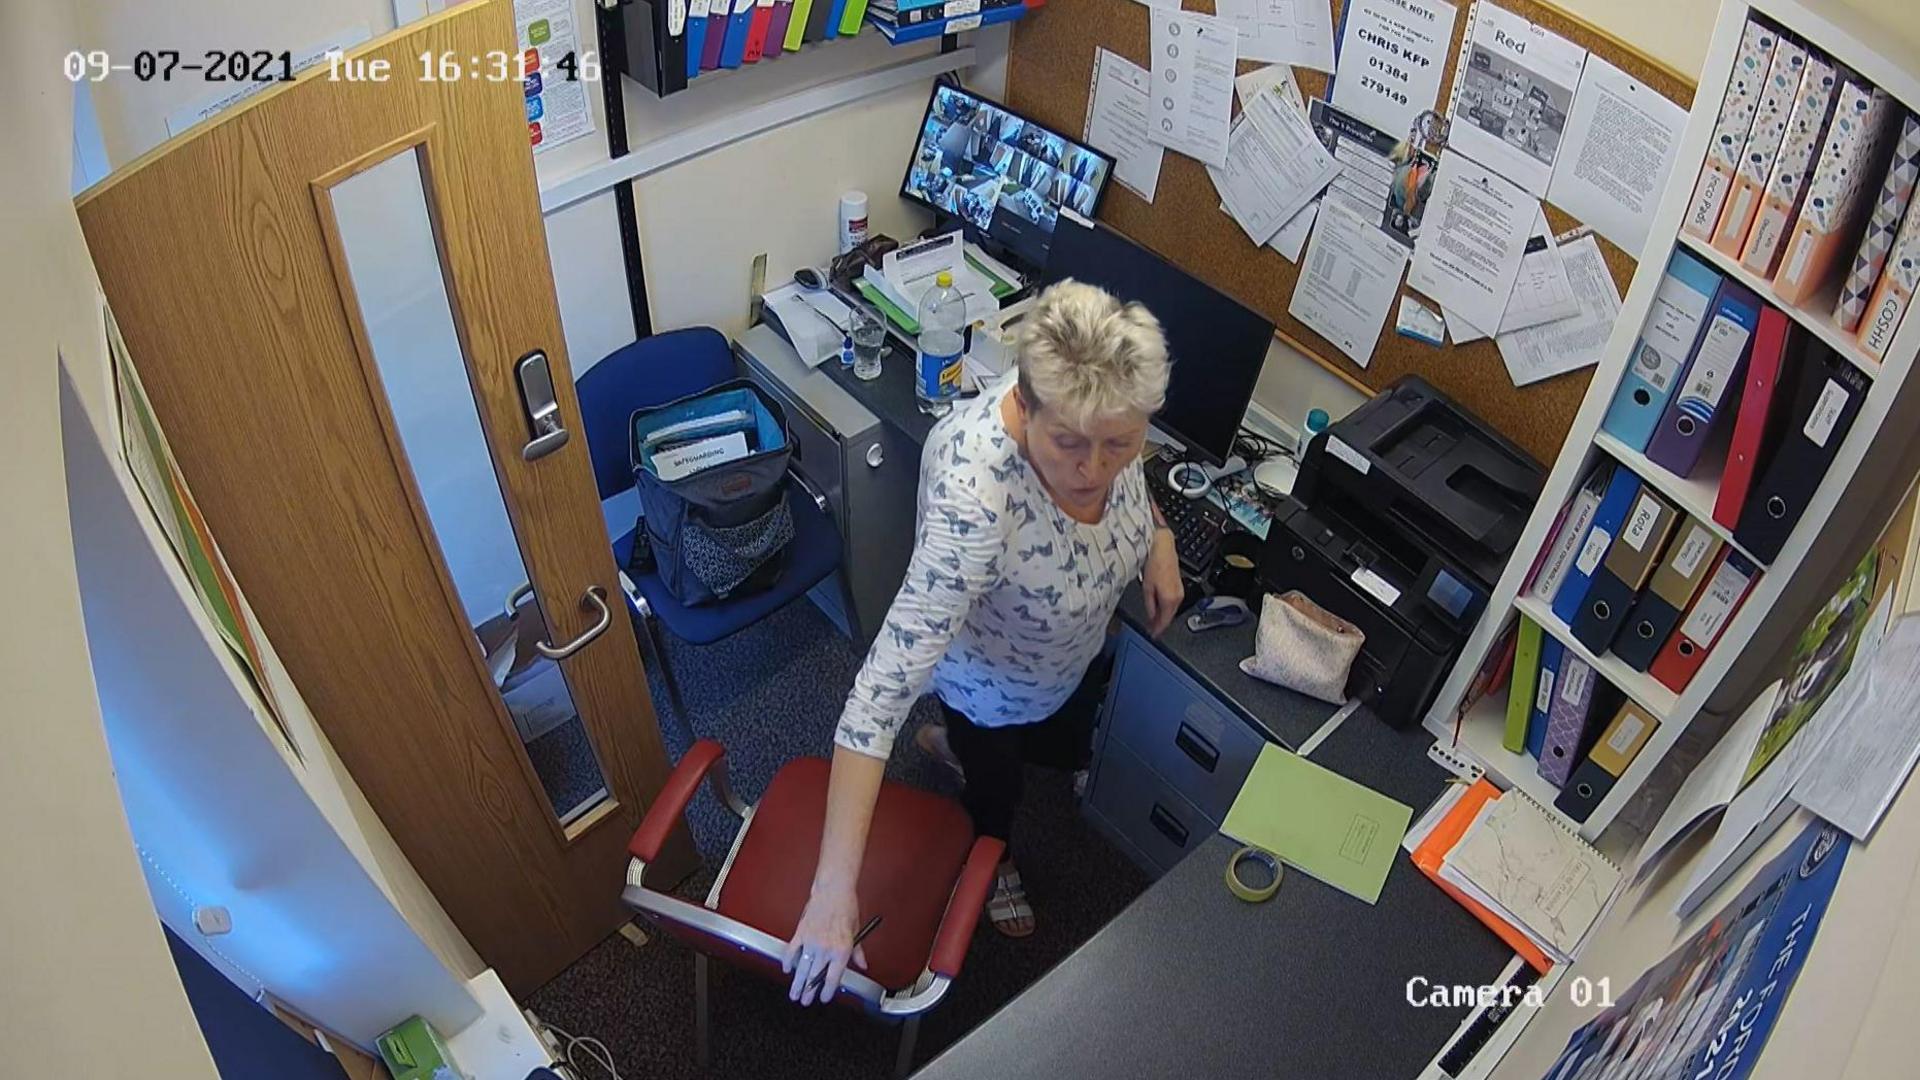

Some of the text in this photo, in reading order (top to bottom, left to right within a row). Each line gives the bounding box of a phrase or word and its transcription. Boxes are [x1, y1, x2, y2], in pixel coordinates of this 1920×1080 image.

[1408, 4, 1436, 22] NOTE
[1358, 28, 1400, 55] CHRIS
[1494, 29, 1527, 55] Red
[1369, 56, 1409, 82] 01384
[1361, 76, 1408, 105] 279149
[1868, 298, 1899, 350] COSHH
[1631, 509, 1651, 538] Rota
[1767, 903, 1812, 979] THE
